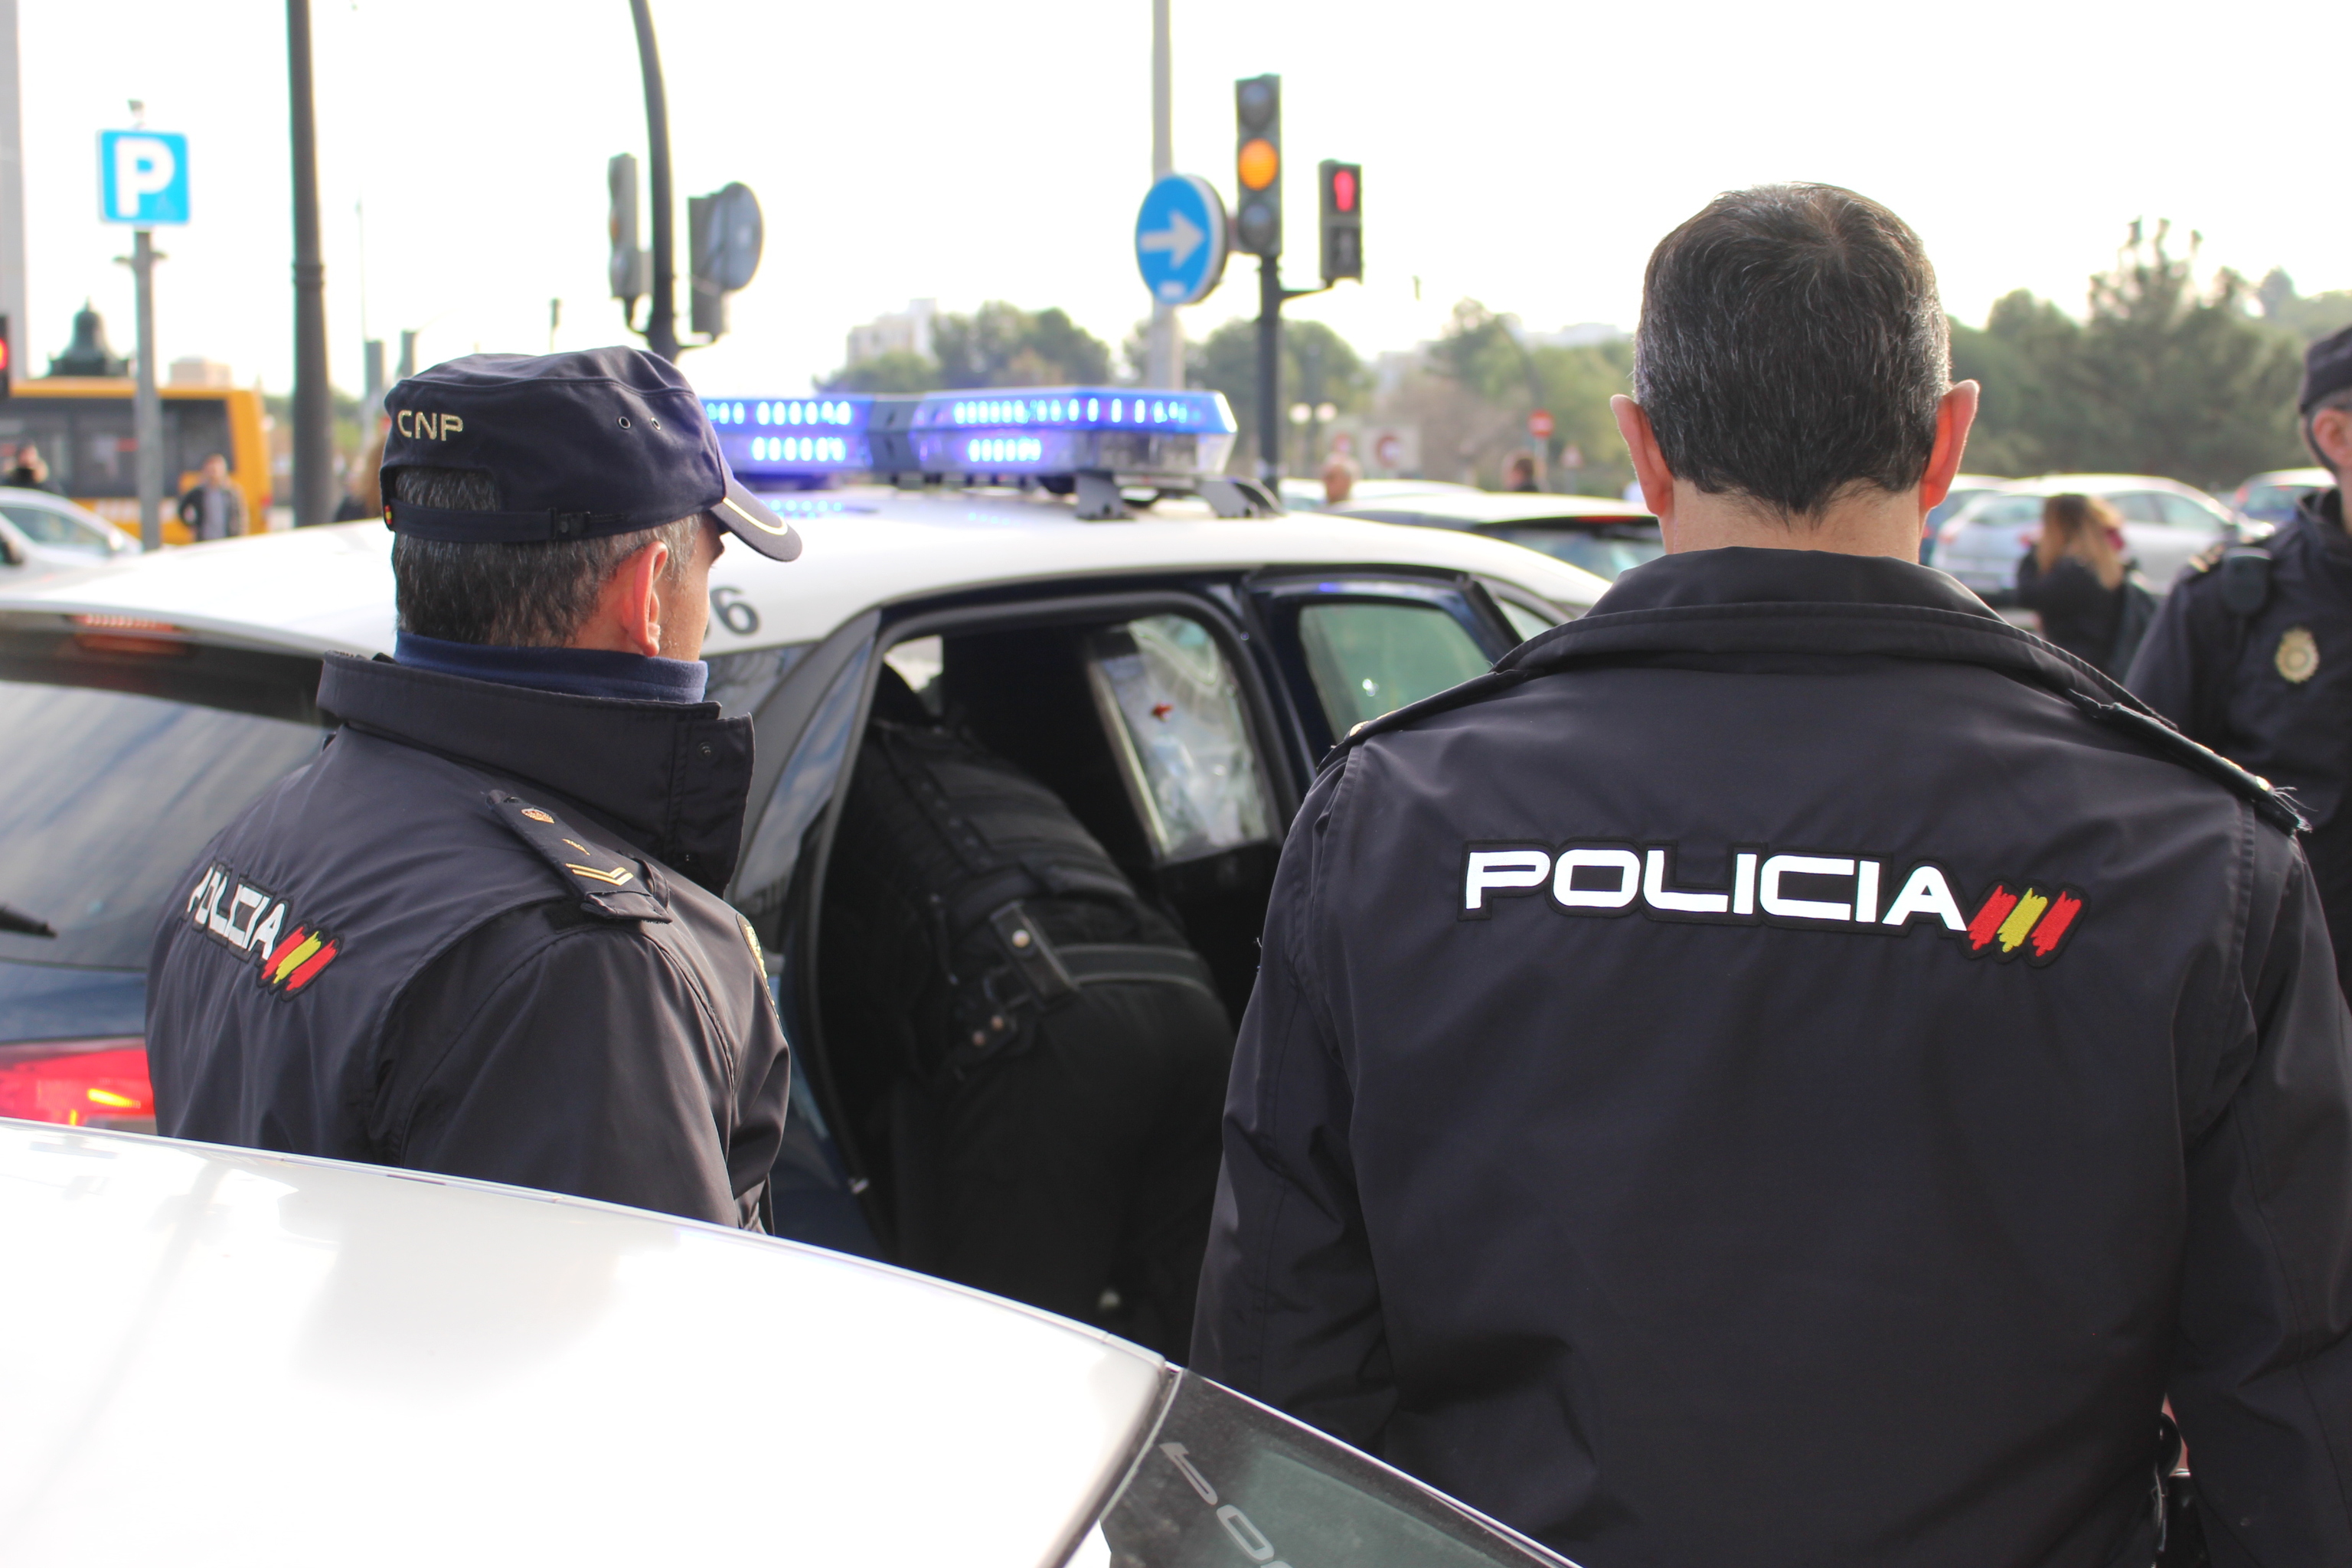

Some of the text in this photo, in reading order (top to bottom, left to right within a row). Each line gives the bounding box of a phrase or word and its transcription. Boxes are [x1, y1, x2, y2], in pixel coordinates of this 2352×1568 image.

[115, 137, 175, 217] P
[397, 410, 463, 441] CNP
[703, 586, 760, 639] 6
[1465, 849, 1967, 931] POLICIA
